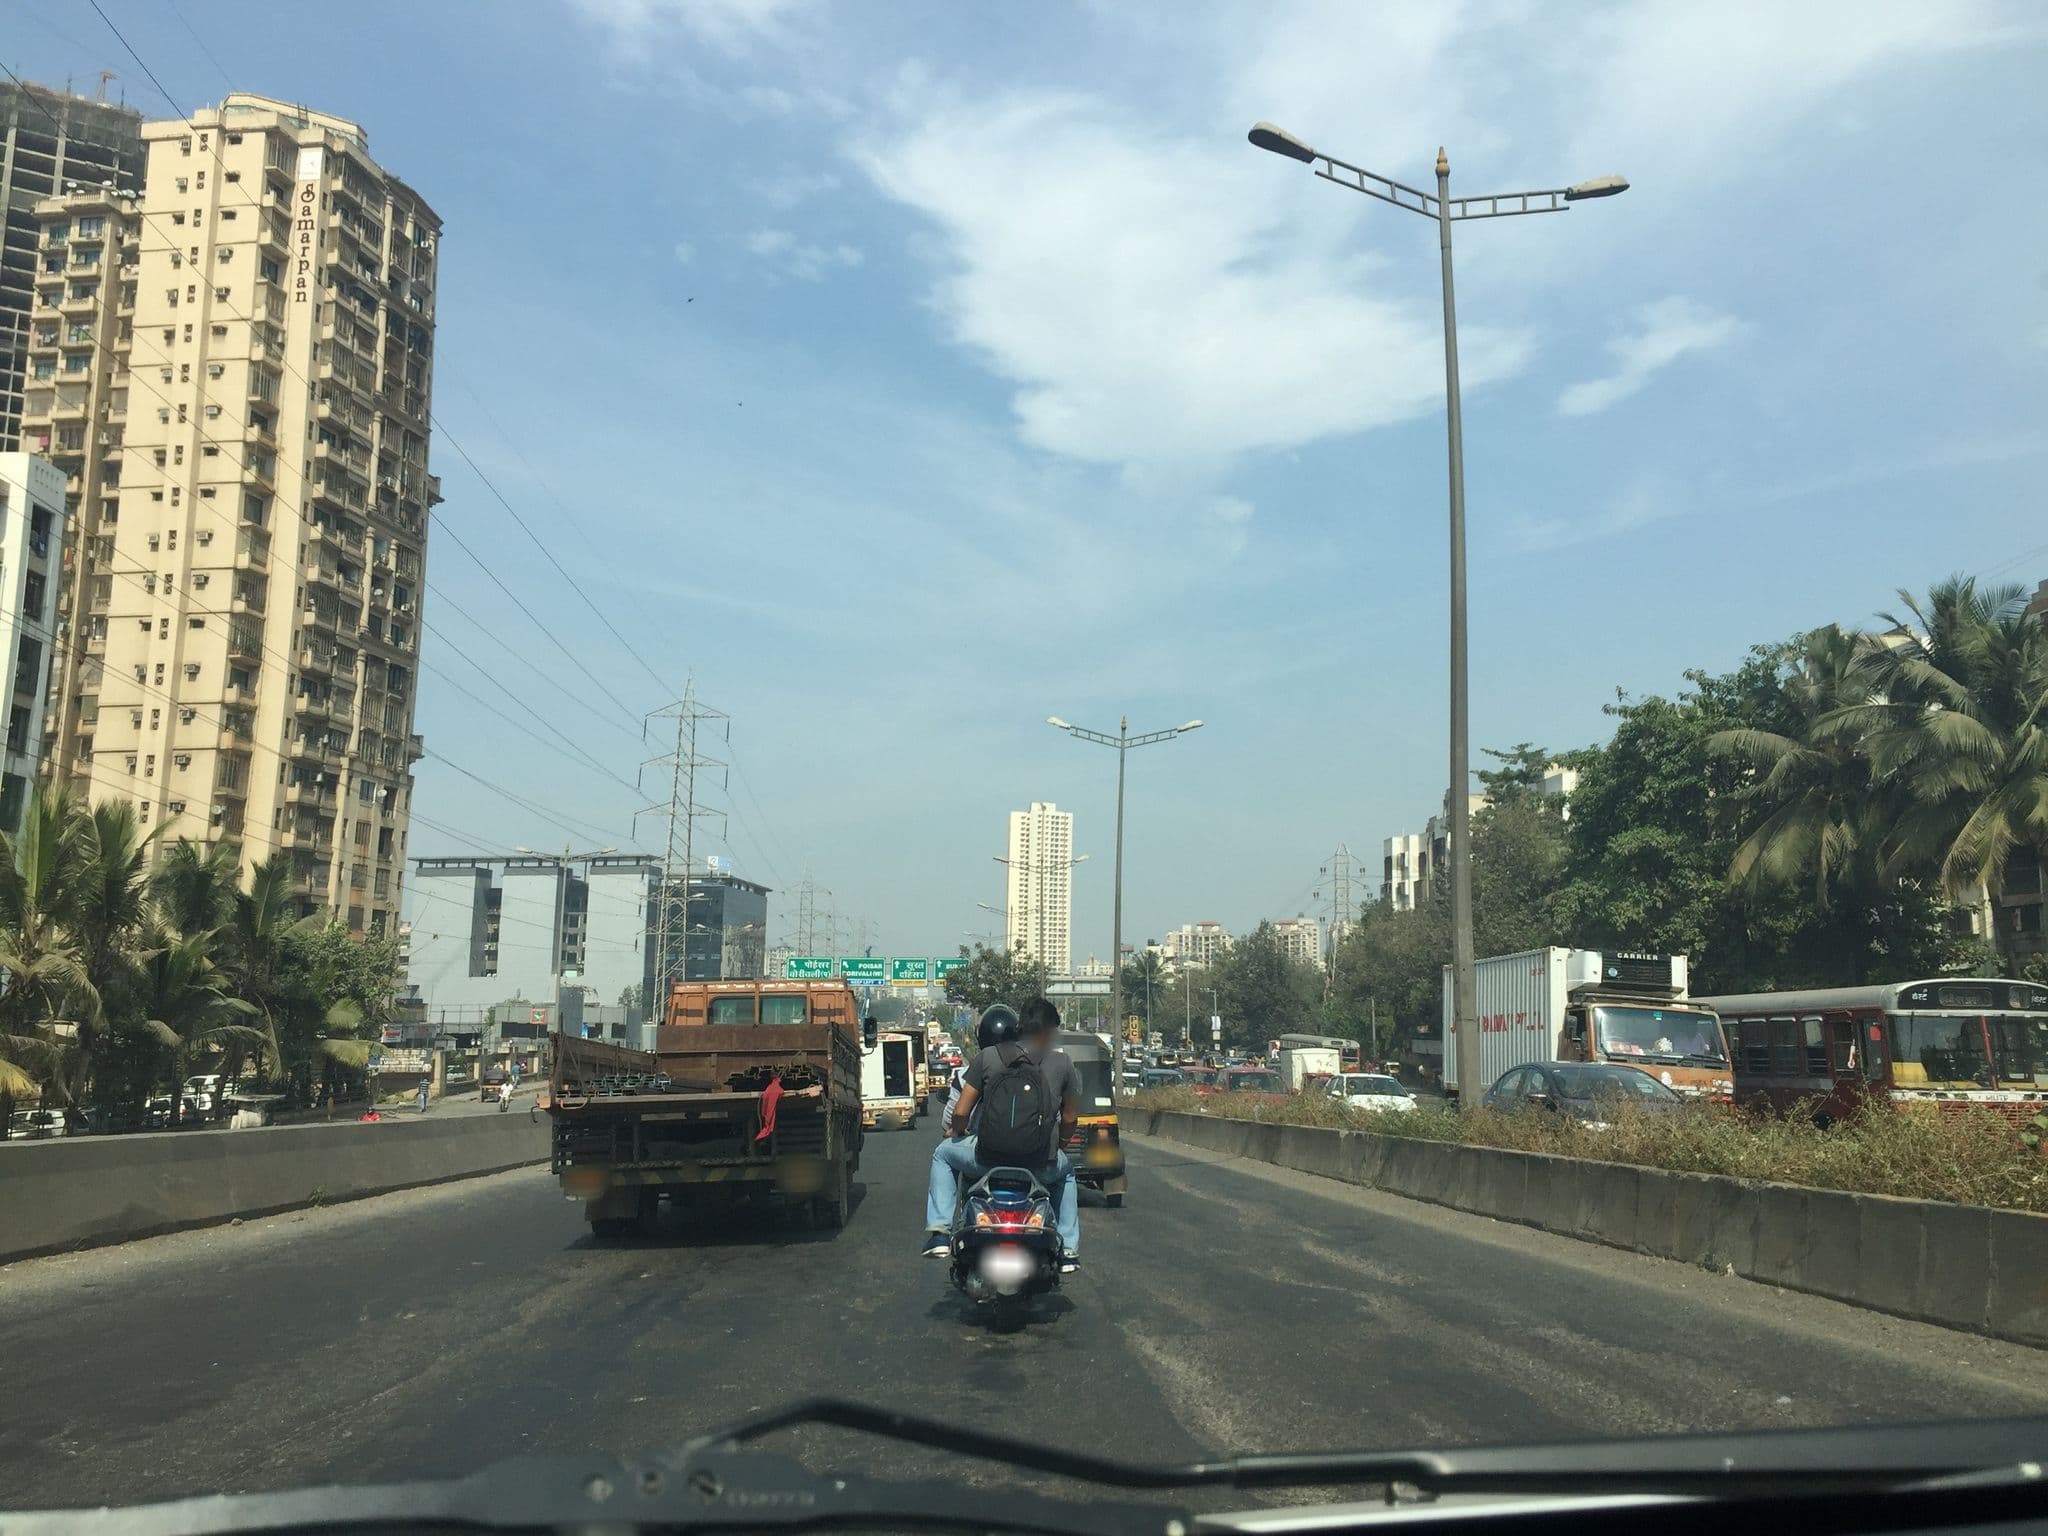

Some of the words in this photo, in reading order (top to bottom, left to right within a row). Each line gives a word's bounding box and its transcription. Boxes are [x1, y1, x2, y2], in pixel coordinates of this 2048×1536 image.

[295, 183, 316, 303] Samarpan
[1616, 952, 1659, 961] CARRIER
[1130, 1016, 1138, 1037] PUC
